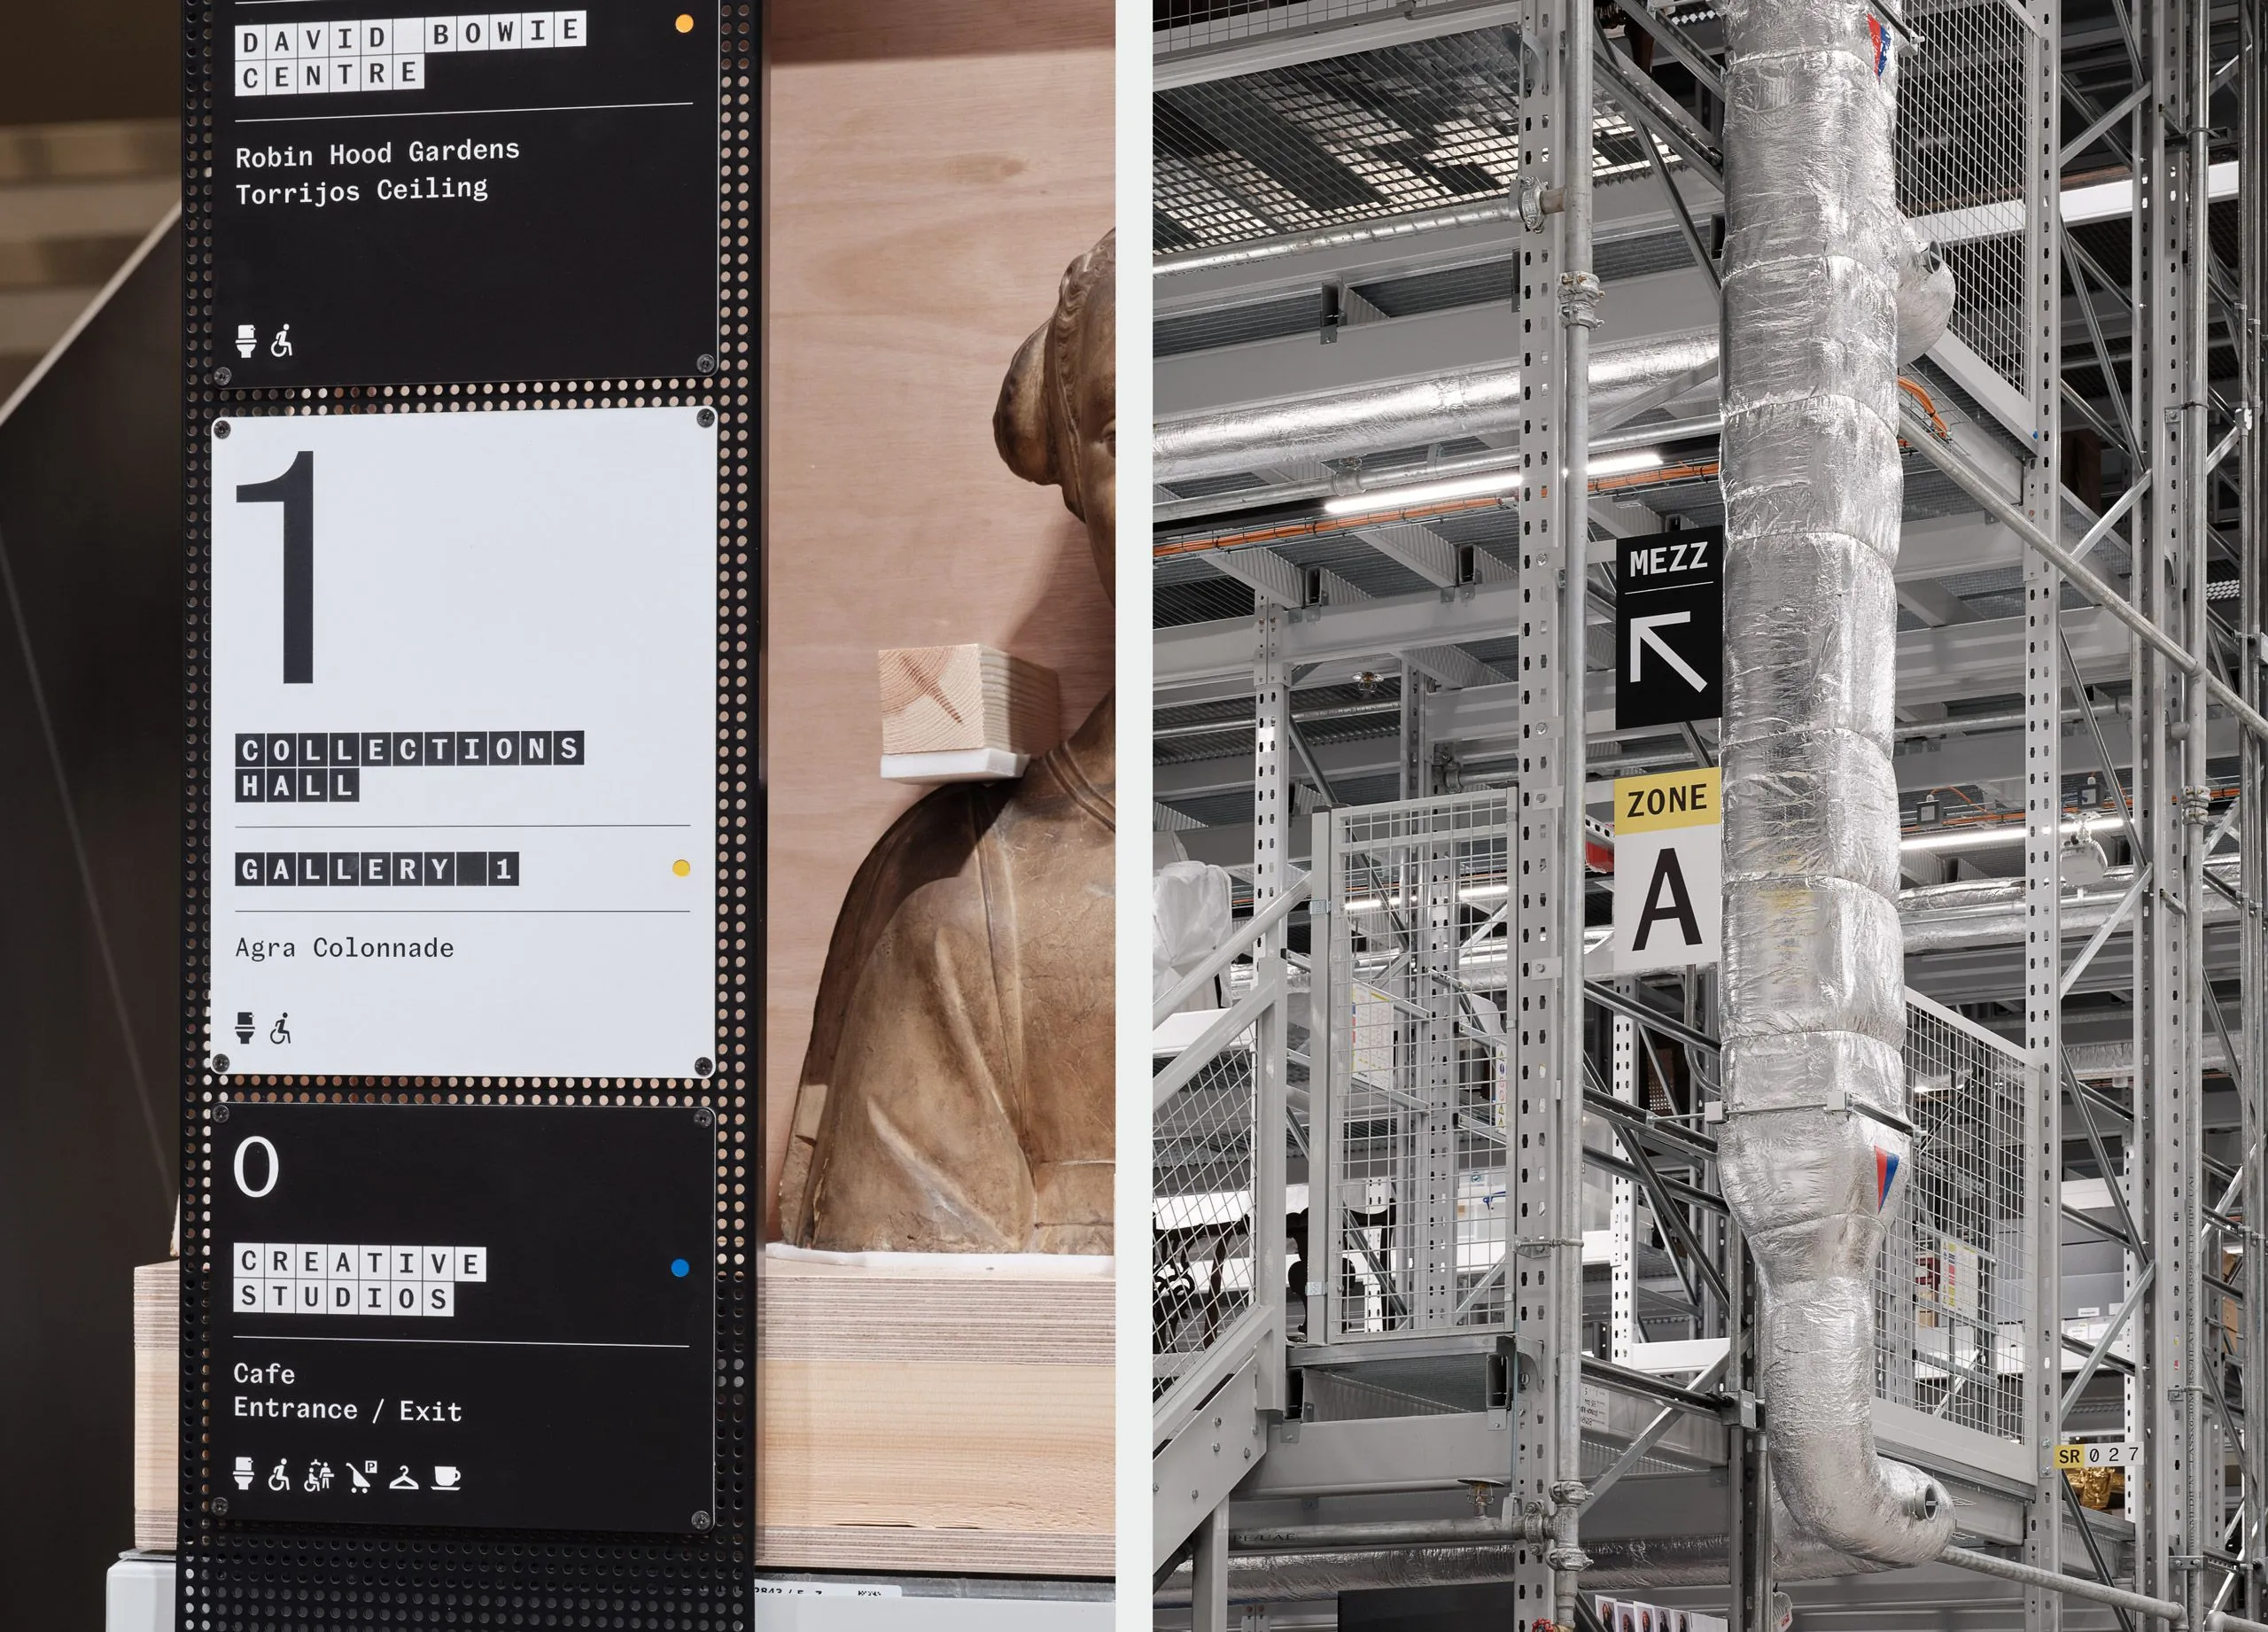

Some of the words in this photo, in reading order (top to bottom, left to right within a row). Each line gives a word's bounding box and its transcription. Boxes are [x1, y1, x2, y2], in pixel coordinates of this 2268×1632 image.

[243, 26, 386, 54] DAVID
[433, 18, 579, 46] BOWIE
[243, 60, 416, 89] CENTRE
[236, 145, 313, 168] Robin
[330, 141, 392, 165] Hood
[408, 138, 520, 162] Gardens
[236, 182, 360, 207] Torrijos
[377, 177, 488, 202] Ceiling
[236, 450, 314, 684] 1
[1630, 541, 1708, 577] MEZZ
[242, 737, 578, 763] COLLECTIONS
[242, 774, 353, 797] HALL
[1627, 783, 1708, 818] ZONE
[242, 858, 449, 881] GALLERY
[496, 858, 511, 880] 1
[1631, 847, 1703, 952] A
[235, 936, 295, 962] Agra
[314, 936, 454, 958] Colonnade
[241, 1249, 478, 1276] CREATIVE
[241, 1285, 447, 1310] STUDIOS
[233, 1362, 295, 1385] Cafe
[234, 1395, 358, 1419] Entrance
[372, 1398, 384, 1425] /
[400, 1400, 462, 1422] Exit
[2059, 1449, 2080, 1465] SR
